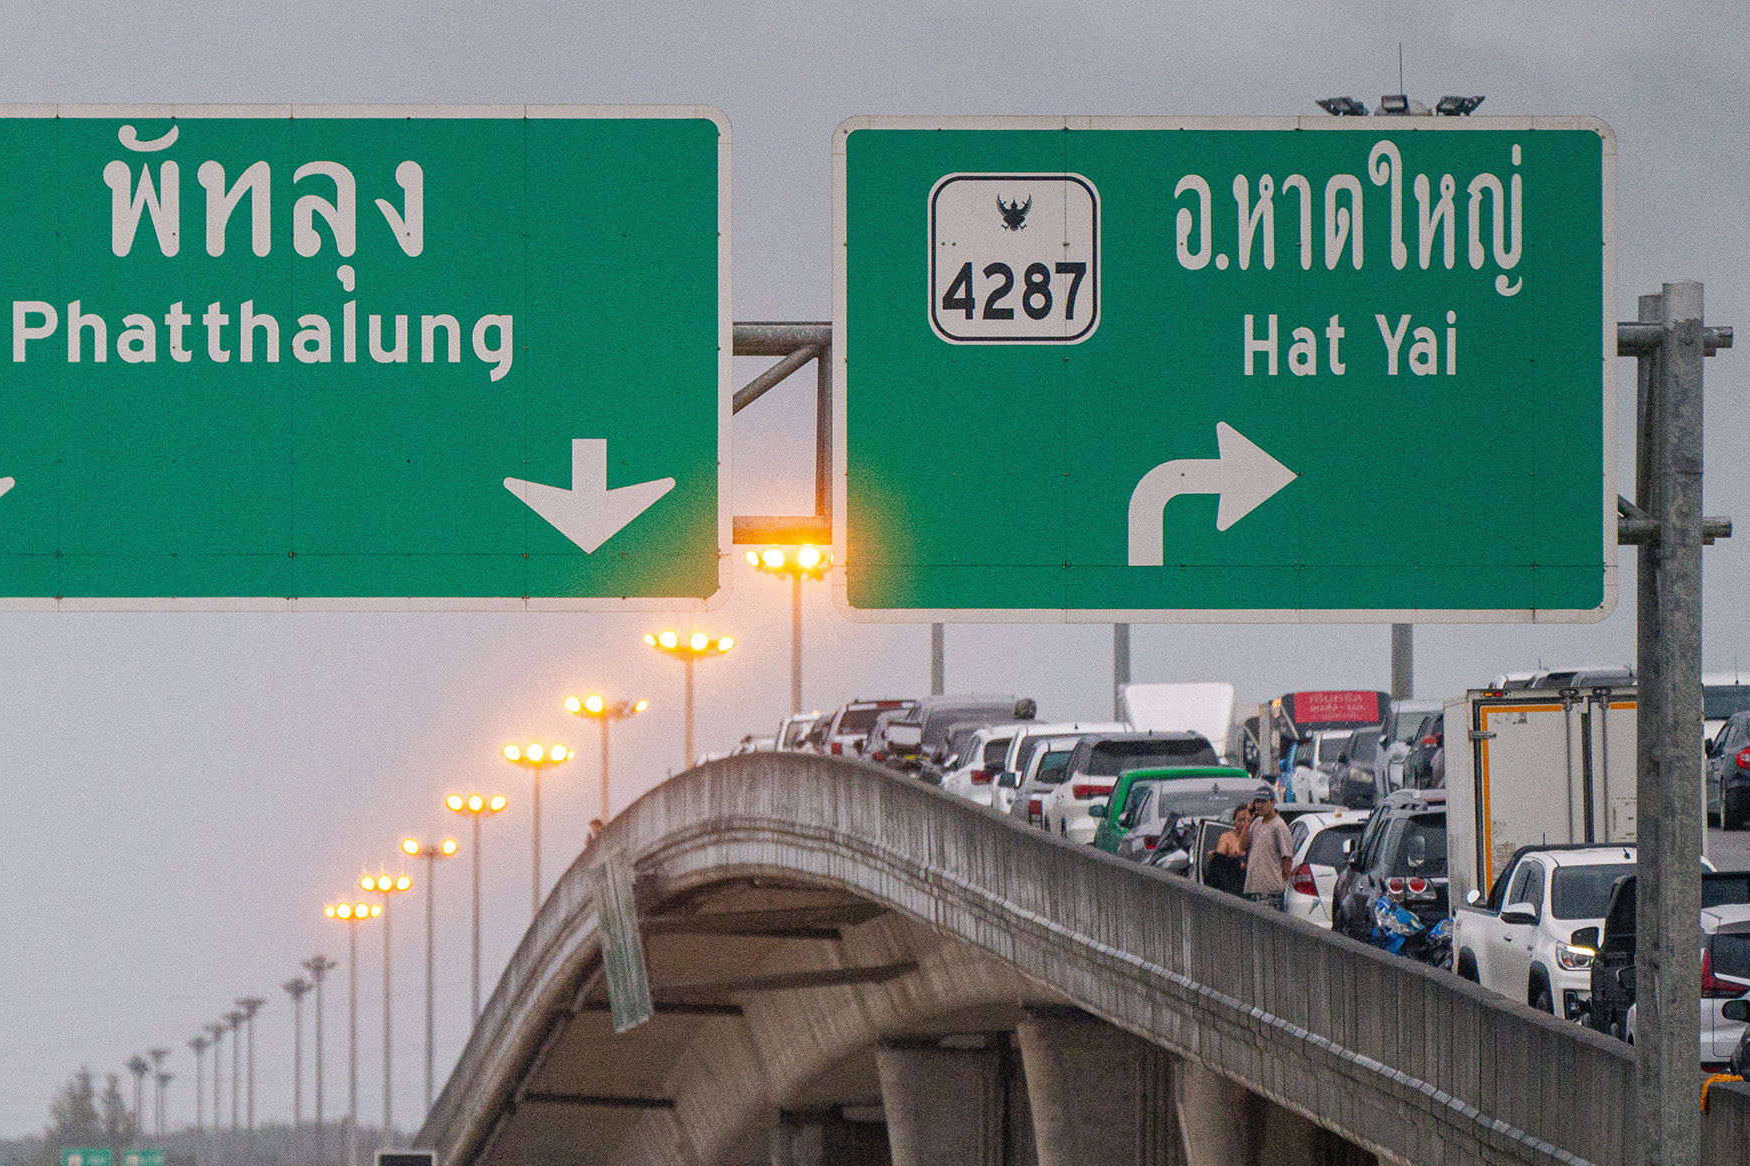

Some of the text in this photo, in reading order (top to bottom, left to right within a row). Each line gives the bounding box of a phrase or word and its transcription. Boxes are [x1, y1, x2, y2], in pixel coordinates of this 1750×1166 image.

[102, 124, 424, 292] พัทลุง
[1174, 139, 1523, 297] อ.หาดใหญ่
[941, 261, 1087, 321] 4287
[11, 299, 515, 382] Phatthalung
[1243, 310, 1458, 376] Hat Yai
